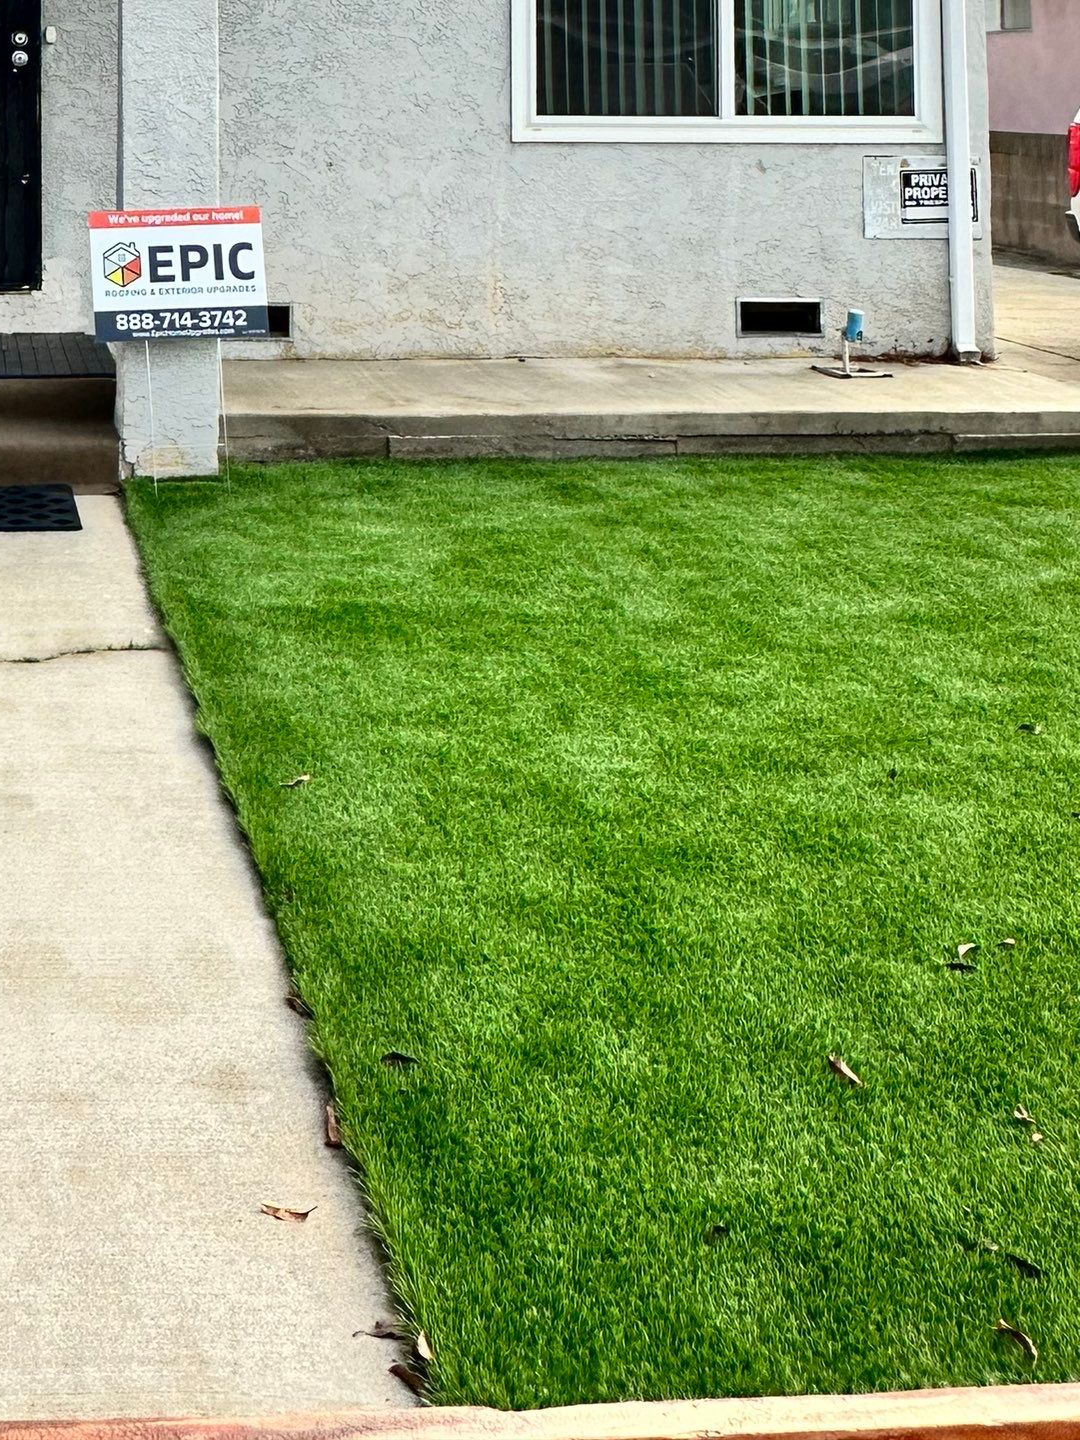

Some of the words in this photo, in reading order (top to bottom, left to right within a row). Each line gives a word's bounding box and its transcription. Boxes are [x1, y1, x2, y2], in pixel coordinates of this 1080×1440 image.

[910, 173, 947, 187] PRIVA
[904, 186, 947, 200] PROPE
[107, 213, 140, 225] We've
[141, 212, 191, 225] upgraded
[192, 212, 210, 221] our
[211, 210, 244, 221] home!
[148, 241, 256, 283] EPIC
[158, 287, 204, 296] EXTERIOR
[206, 285, 257, 294] UPGRADES
[115, 309, 248, 330] 888-714-3742
